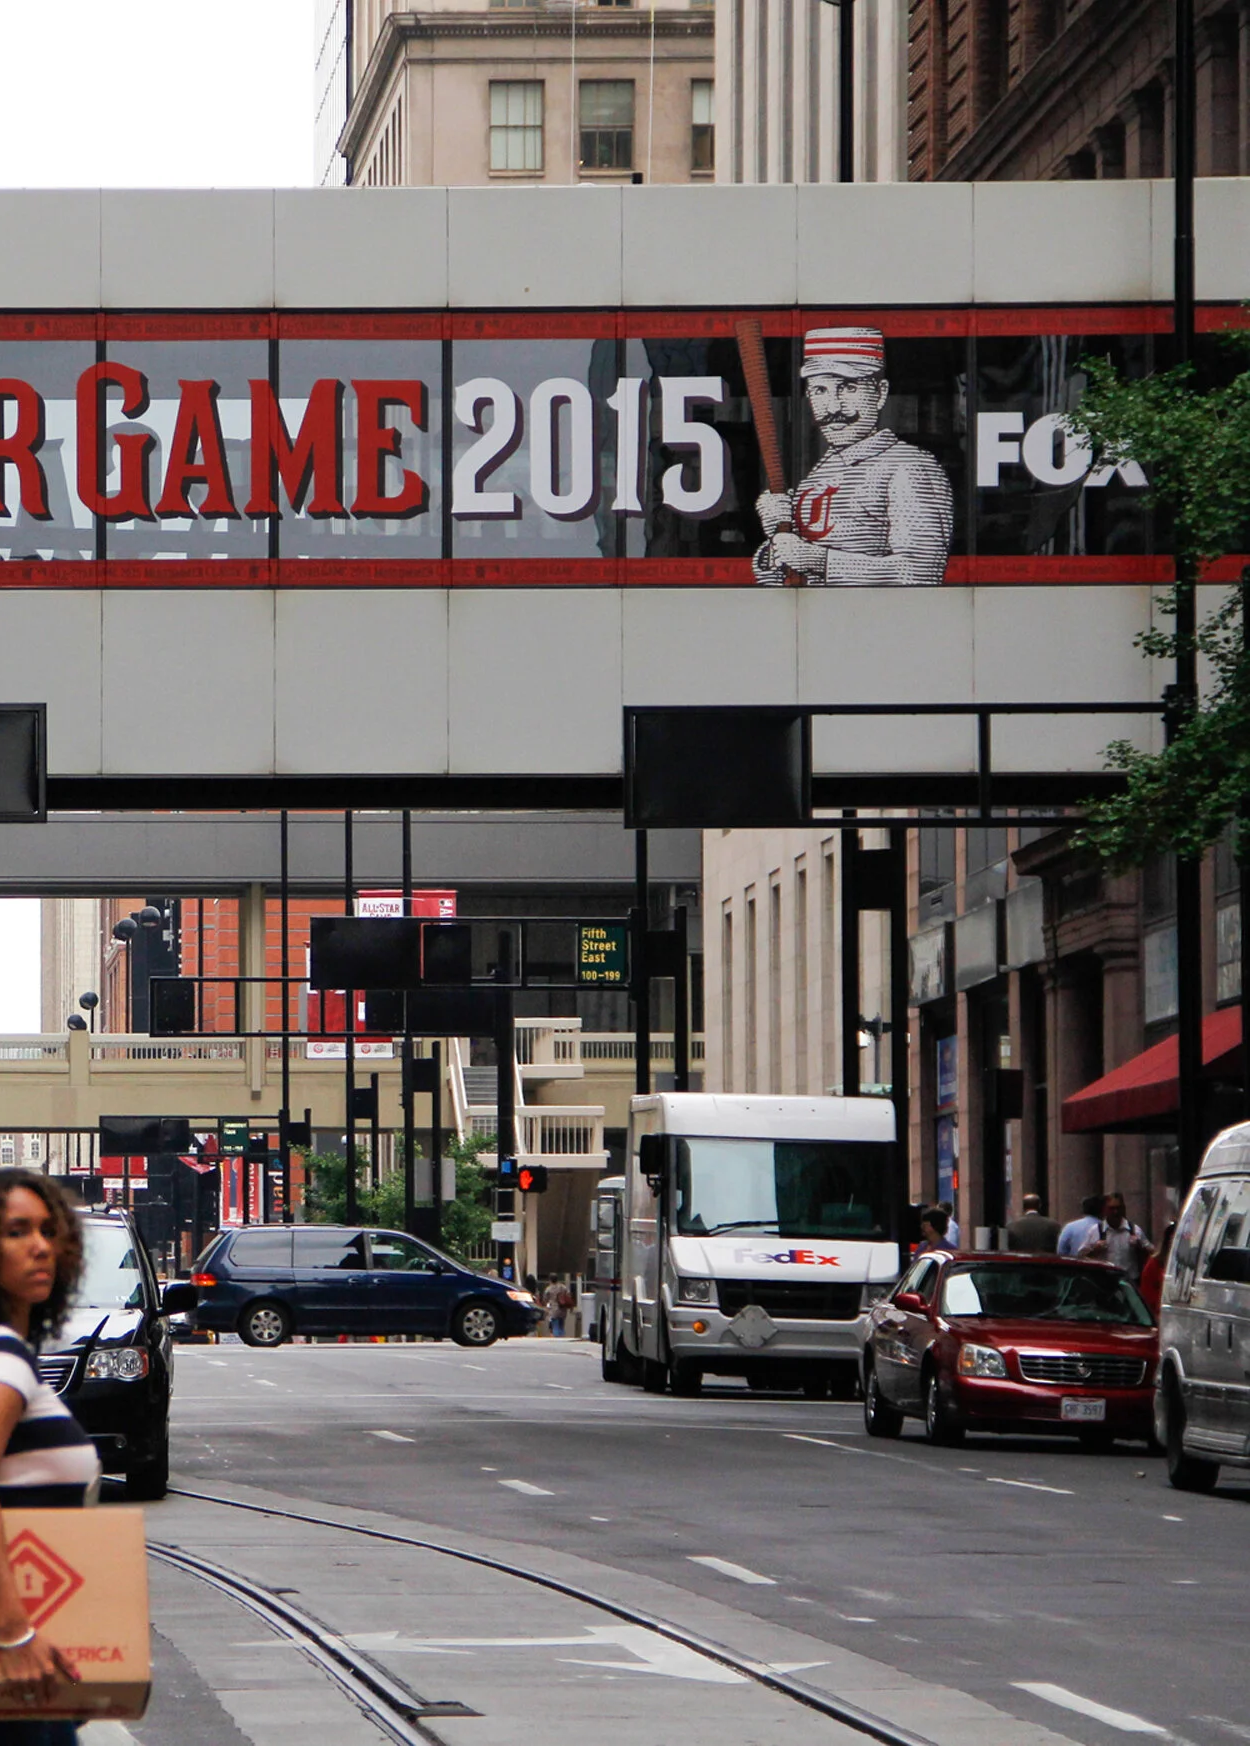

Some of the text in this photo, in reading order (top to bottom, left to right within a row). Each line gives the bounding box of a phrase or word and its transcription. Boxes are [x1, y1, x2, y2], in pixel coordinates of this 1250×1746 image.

[76, 360, 432, 519] GAME
[452, 376, 729, 518] 2015
[977, 412, 1149, 486] FOX
[581, 927, 607, 939] Fifth
[581, 939, 617, 951] Street
[581, 951, 606, 963] East
[581, 970, 621, 981] 100-199
[734, 1248, 842, 1267] FedEx
[68, 1647, 124, 1663] ERICA
